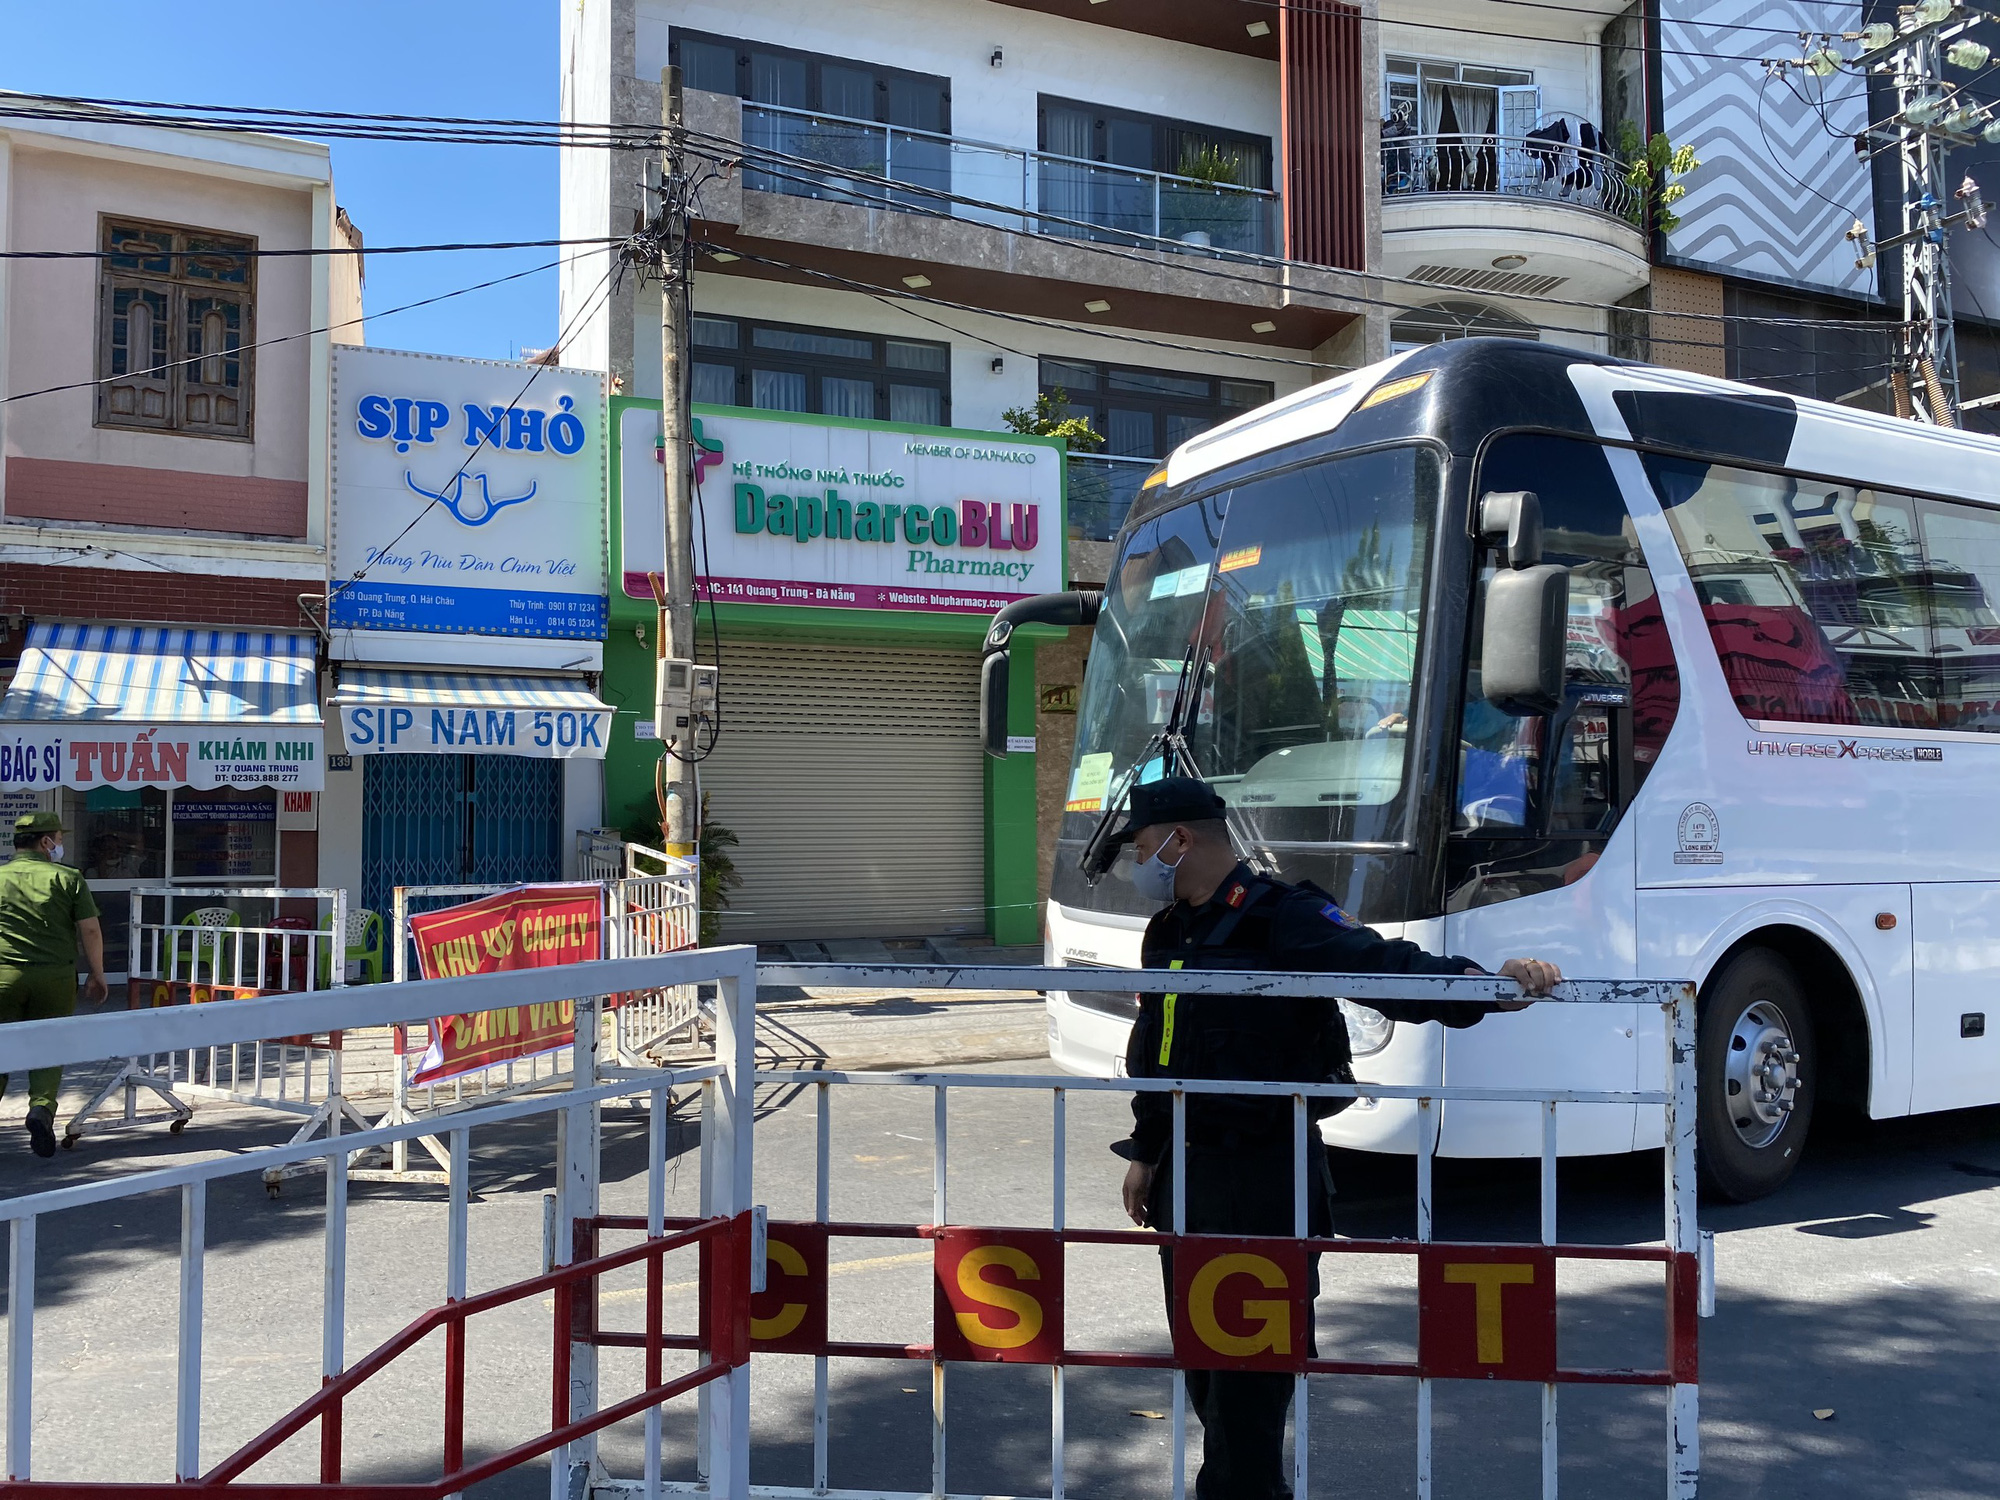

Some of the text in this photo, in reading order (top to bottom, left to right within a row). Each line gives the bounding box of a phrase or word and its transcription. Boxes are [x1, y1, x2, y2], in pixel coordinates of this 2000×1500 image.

[357, 395, 585, 454] SỊP NHỎ
[905, 442, 1036, 464] MEMBER OF DAPHARCO
[732, 459, 905, 488] HỆ THỐNG NHÀ THUỐC
[366, 547, 578, 577] Nâng Niu Đàn Chim Việt
[906, 550, 1034, 582] Pharmacy
[357, 591, 383, 603] Quang
[727, 583, 743, 595] 141
[747, 584, 777, 598] Quang
[549, 601, 565, 611] 0901
[568, 602, 577, 611] 87
[579, 603, 596, 612] 1234
[889, 592, 1008, 609] Website: blupharmacy.com
[547, 617, 565, 627] 0814
[568, 617, 577, 627] 05
[578, 618, 596, 627] 1234
[350, 707, 602, 752] SỊP NAM 50K
[1, 728, 314, 783] BÁC SĨ TUẤN KHÁM NHI
[330, 755, 350, 768] 139
[1917, 748, 1942, 760] NOBLE
[215, 764, 299, 774] 137 QUANG TRUNG
[215, 774, 299, 782] ĐT: 02363.888 277
[187, 804, 213, 812] QUANG
[431, 935, 480, 978] KHU
[521, 908, 565, 953] CÁCH
[571, 912, 589, 946] LY
